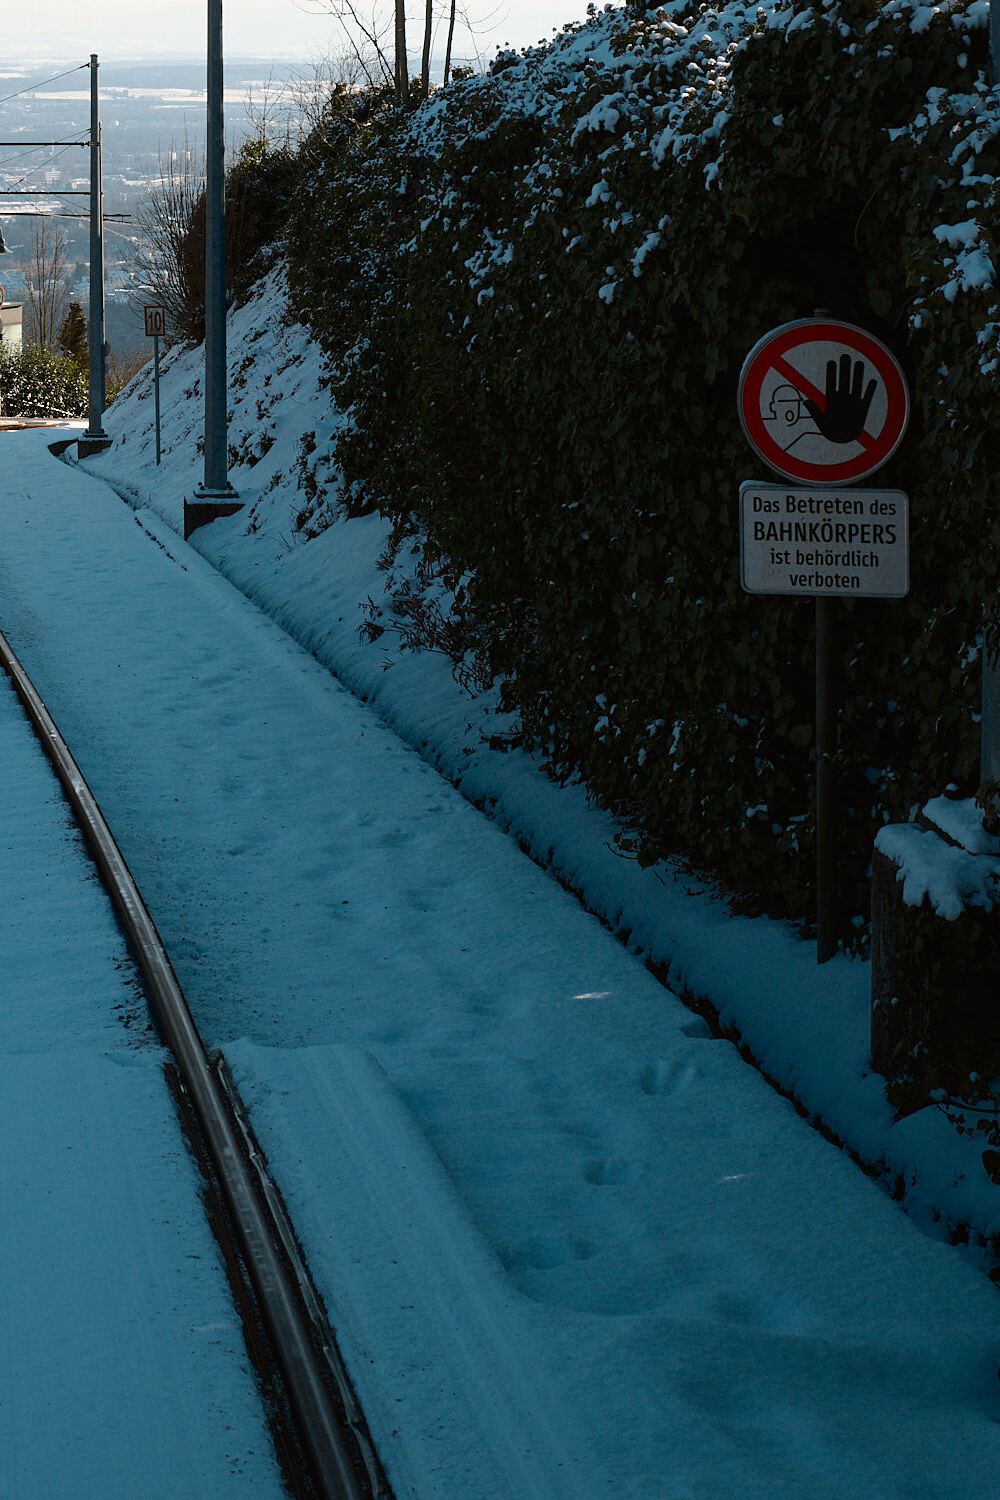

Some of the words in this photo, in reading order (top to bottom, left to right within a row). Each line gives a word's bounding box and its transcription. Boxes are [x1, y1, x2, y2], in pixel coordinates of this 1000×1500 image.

[148, 311, 162, 332] 10
[753, 496, 780, 513] Das
[786, 495, 863, 515] Betreten
[869, 499, 897, 516] des
[753, 517, 897, 544] BAHNKÖRPERS
[769, 547, 790, 565] ist
[796, 548, 879, 567] behördlich
[789, 570, 860, 588] verboten
